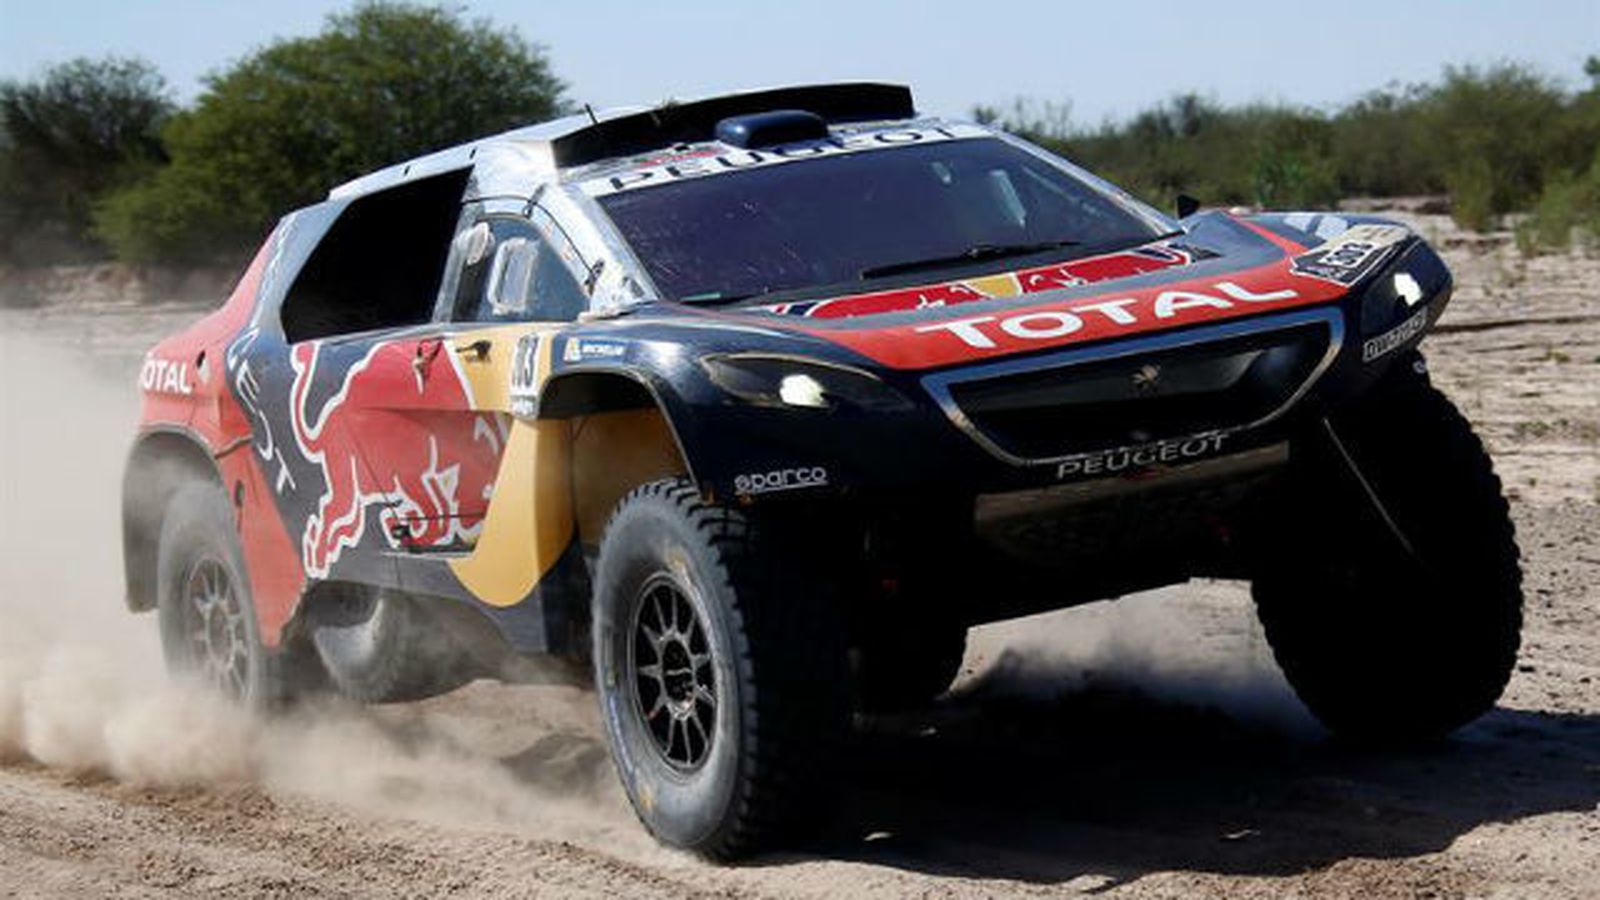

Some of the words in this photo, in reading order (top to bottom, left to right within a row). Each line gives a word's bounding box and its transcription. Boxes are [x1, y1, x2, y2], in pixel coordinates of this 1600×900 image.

[916, 281, 1298, 350] TOTAL
[139, 358, 193, 394] OTAL
[1056, 432, 1230, 480] PEUGEOT
[734, 466, 828, 495] sparco
